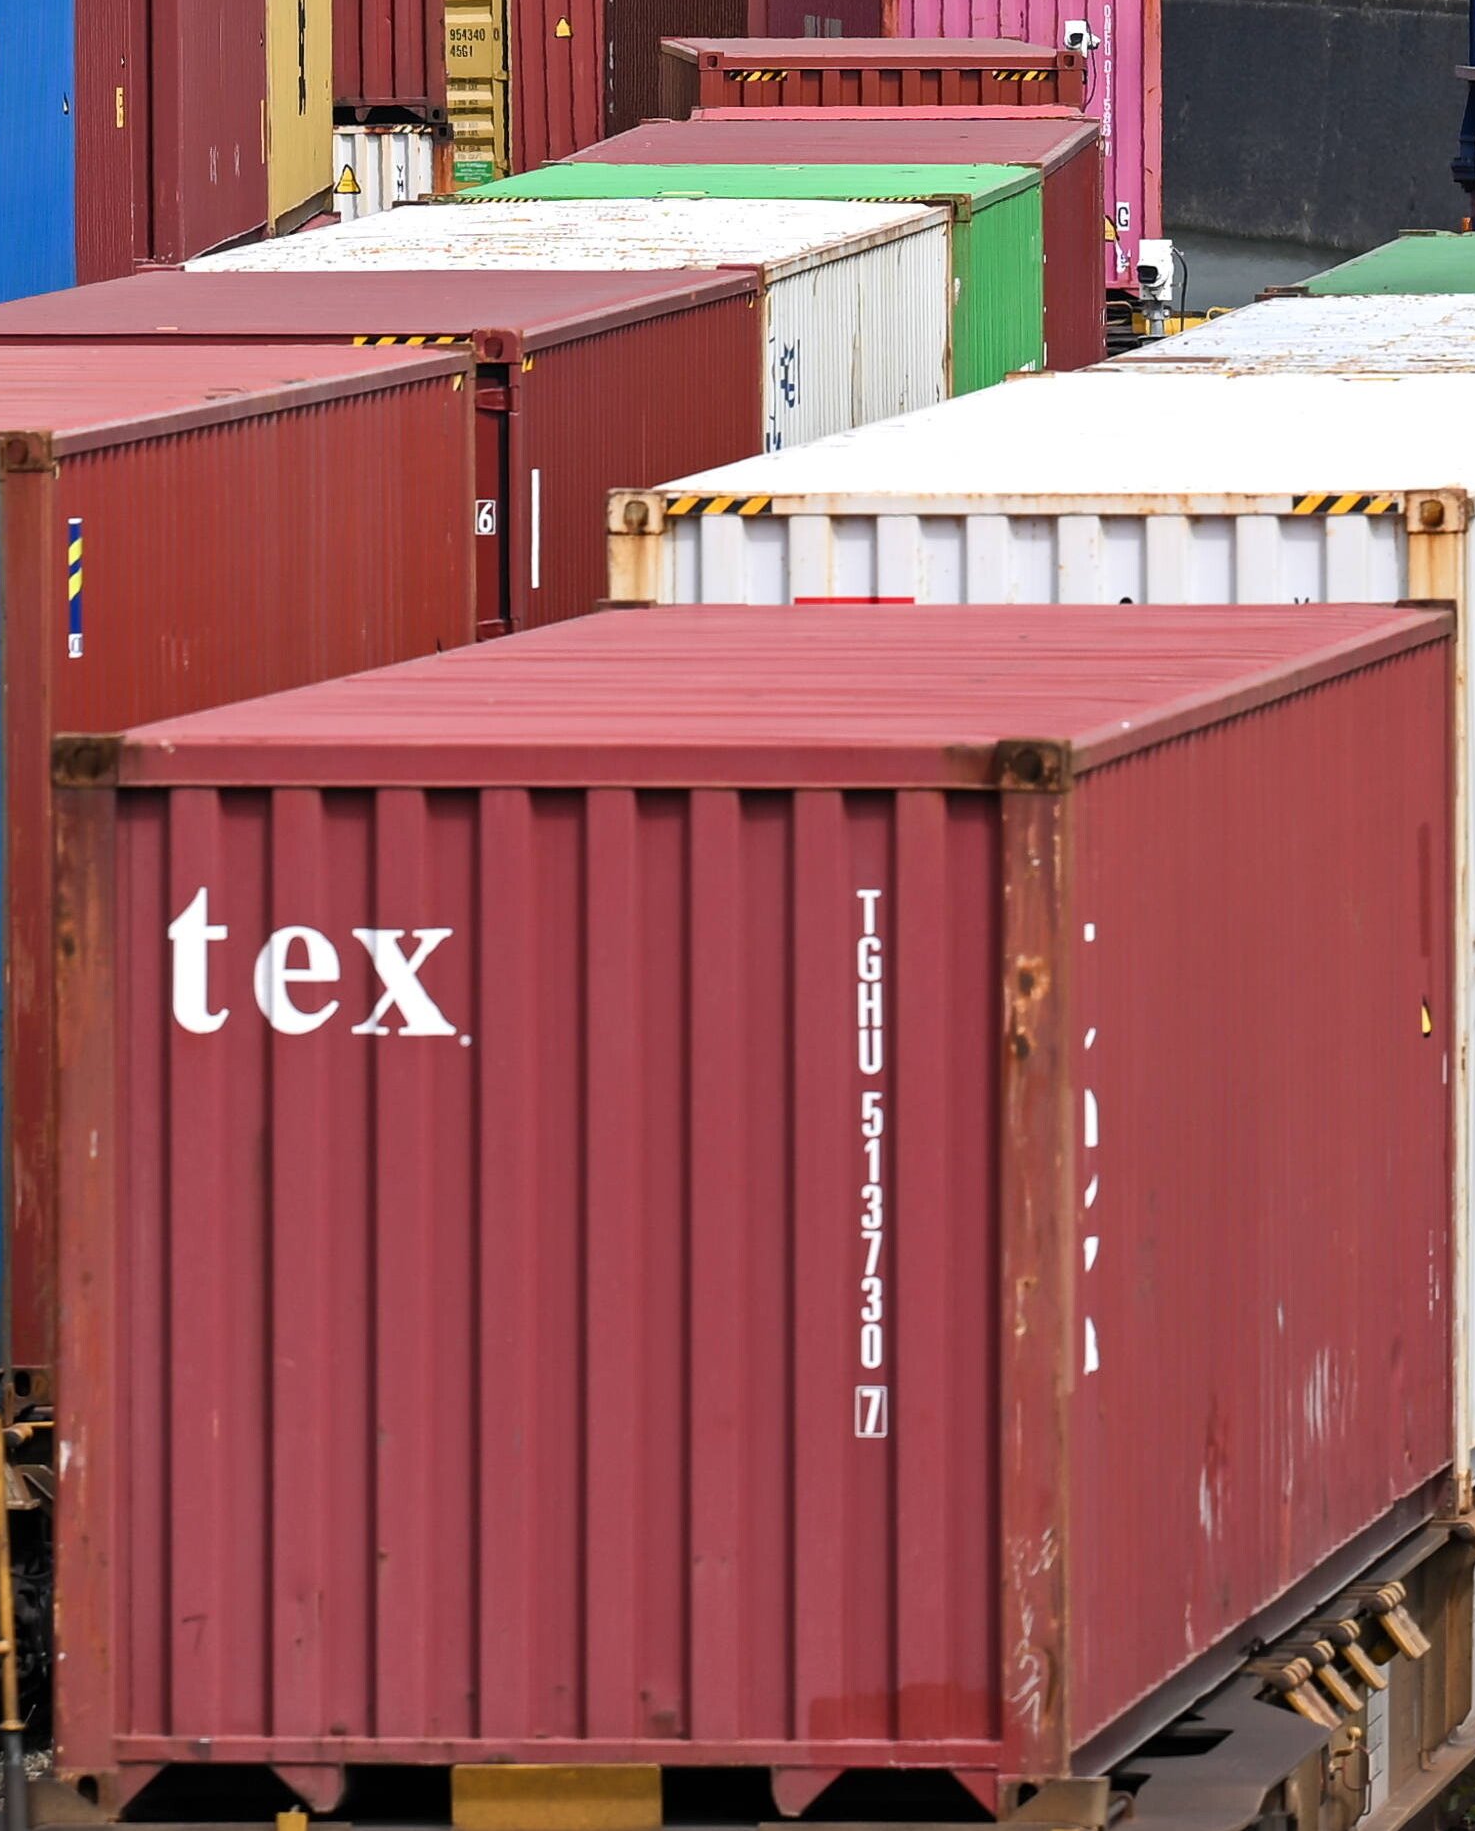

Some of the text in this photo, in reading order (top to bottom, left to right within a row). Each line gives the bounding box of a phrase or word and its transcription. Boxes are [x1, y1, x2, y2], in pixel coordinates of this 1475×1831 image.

[449, 28, 486, 42] 954340
[856, 889, 883, 1075] TGHU
[859, 1091, 886, 1370] 513730
